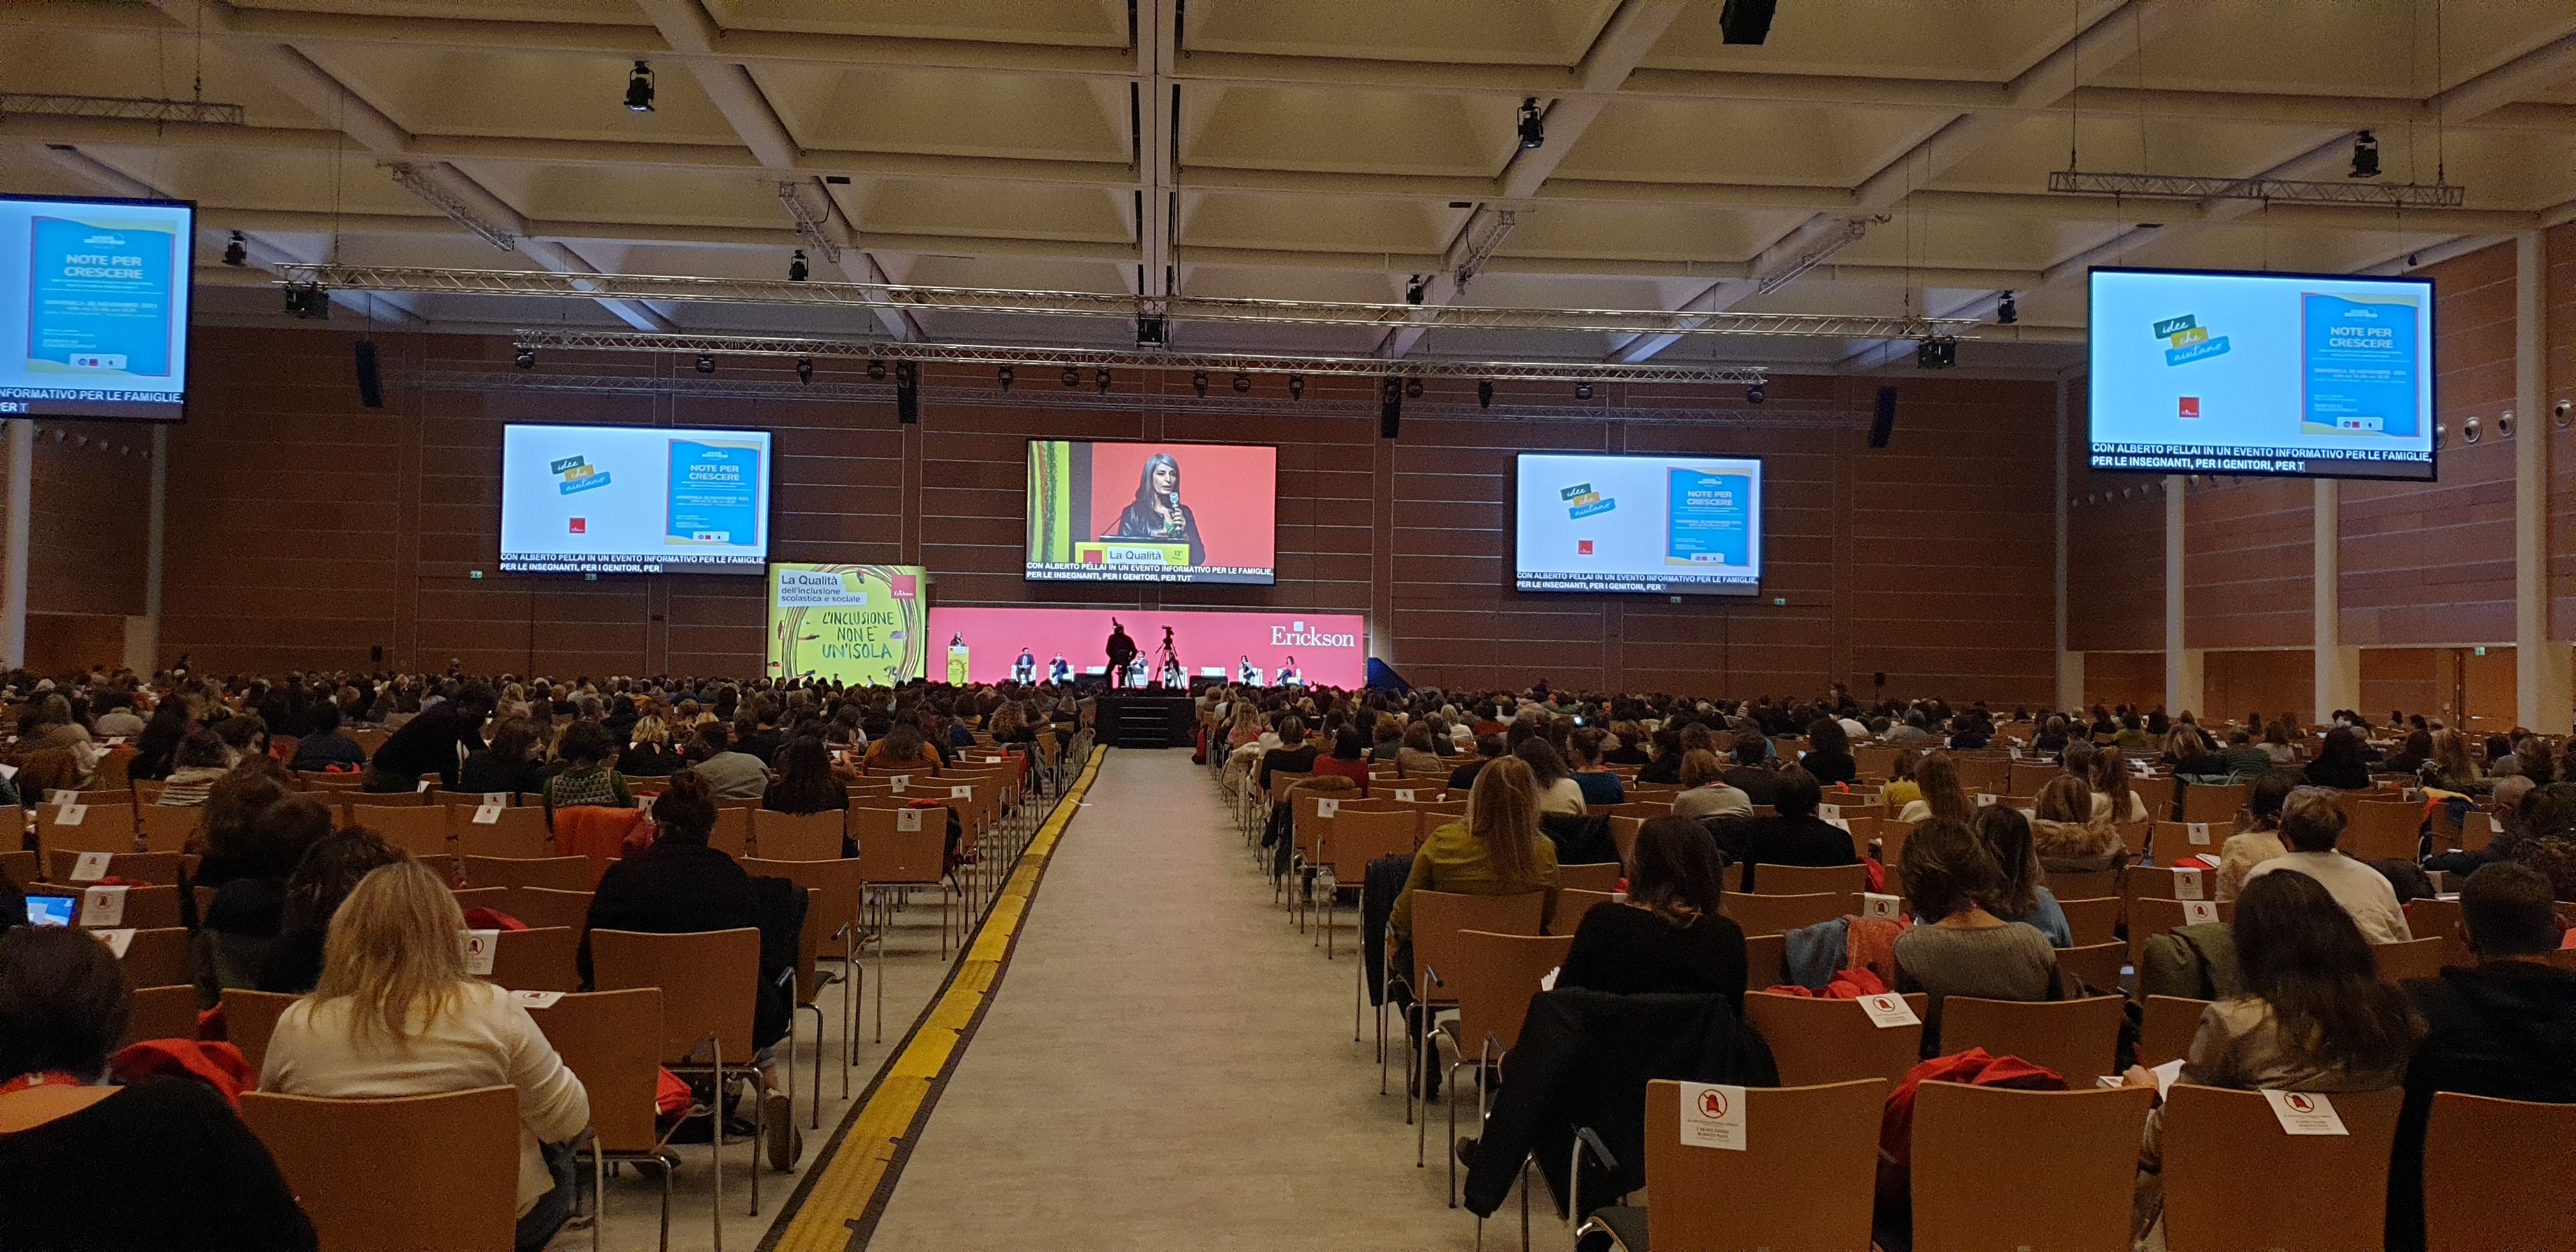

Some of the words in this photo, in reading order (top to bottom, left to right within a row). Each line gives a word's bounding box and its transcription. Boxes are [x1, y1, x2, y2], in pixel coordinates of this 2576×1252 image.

[66, 254, 108, 265] NOTE
[112, 256, 142, 266] PER
[64, 266, 144, 279] CRESCERE
[2163, 321, 2189, 334] idee
[2331, 327, 2365, 336] NOTE
[2368, 328, 2392, 337] PER
[2180, 332, 2202, 345] che
[2329, 338, 2394, 349] CRESCERE
[2174, 342, 2223, 362] aiutano
[0, 388, 77, 399] NFORMATIVO
[79, 390, 103, 400] PER
[107, 391, 122, 401] LE
[124, 392, 183, 404] FAMIGLIE,
[0, 402, 18, 412] ER
[2092, 443, 2114, 452] CON
[2117, 443, 2164, 454] ALBERTO
[2166, 445, 2201, 455] PELLAI
[2204, 446, 2214, 455] IN
[2216, 447, 2231, 455] UN
[2234, 447, 2273, 457] EVENTO
[2276, 448, 2343, 459] INFORMATIVO
[2346, 450, 2366, 459] PER
[2368, 450, 2380, 460] LE
[2382, 451, 2432, 462] FAMIGLIE,
[2092, 456, 2113, 466] PER
[2115, 457, 2127, 466] LE
[2129, 457, 2194, 470] INSEGNANTI,
[2196, 459, 2216, 468] PER
[2218, 459, 2221, 468] I
[2223, 459, 2273, 471] GENITORI,
[2276, 461, 2296, 470] PER
[2297, 461, 2304, 471] T
[689, 473, 740, 481] CRESCERE
[1110, 551, 1122, 560] La
[1126, 551, 1162, 560] Qualità
[529, 563, 580, 572] INSEGNANTI,
[602, 564, 643, 572] GENITORI,
[1238, 567, 1273, 576] FAMIGLIE,
[781, 575, 795, 584] La
[799, 576, 838, 585] Qualità
[1054, 572, 1101, 581] INSEGNANTI,
[1123, 573, 1160, 581] GENITORI,
[1722, 576, 1758, 584] FAMIGLIE,
[1609, 583, 1645, 591] GENITORI,
[822, 611, 894, 625] L'INCLUSIONE
[838, 627, 864, 642] NON
[1270, 621, 1355, 647] Erickson
[822, 643, 893, 659] UN'ISOLA
